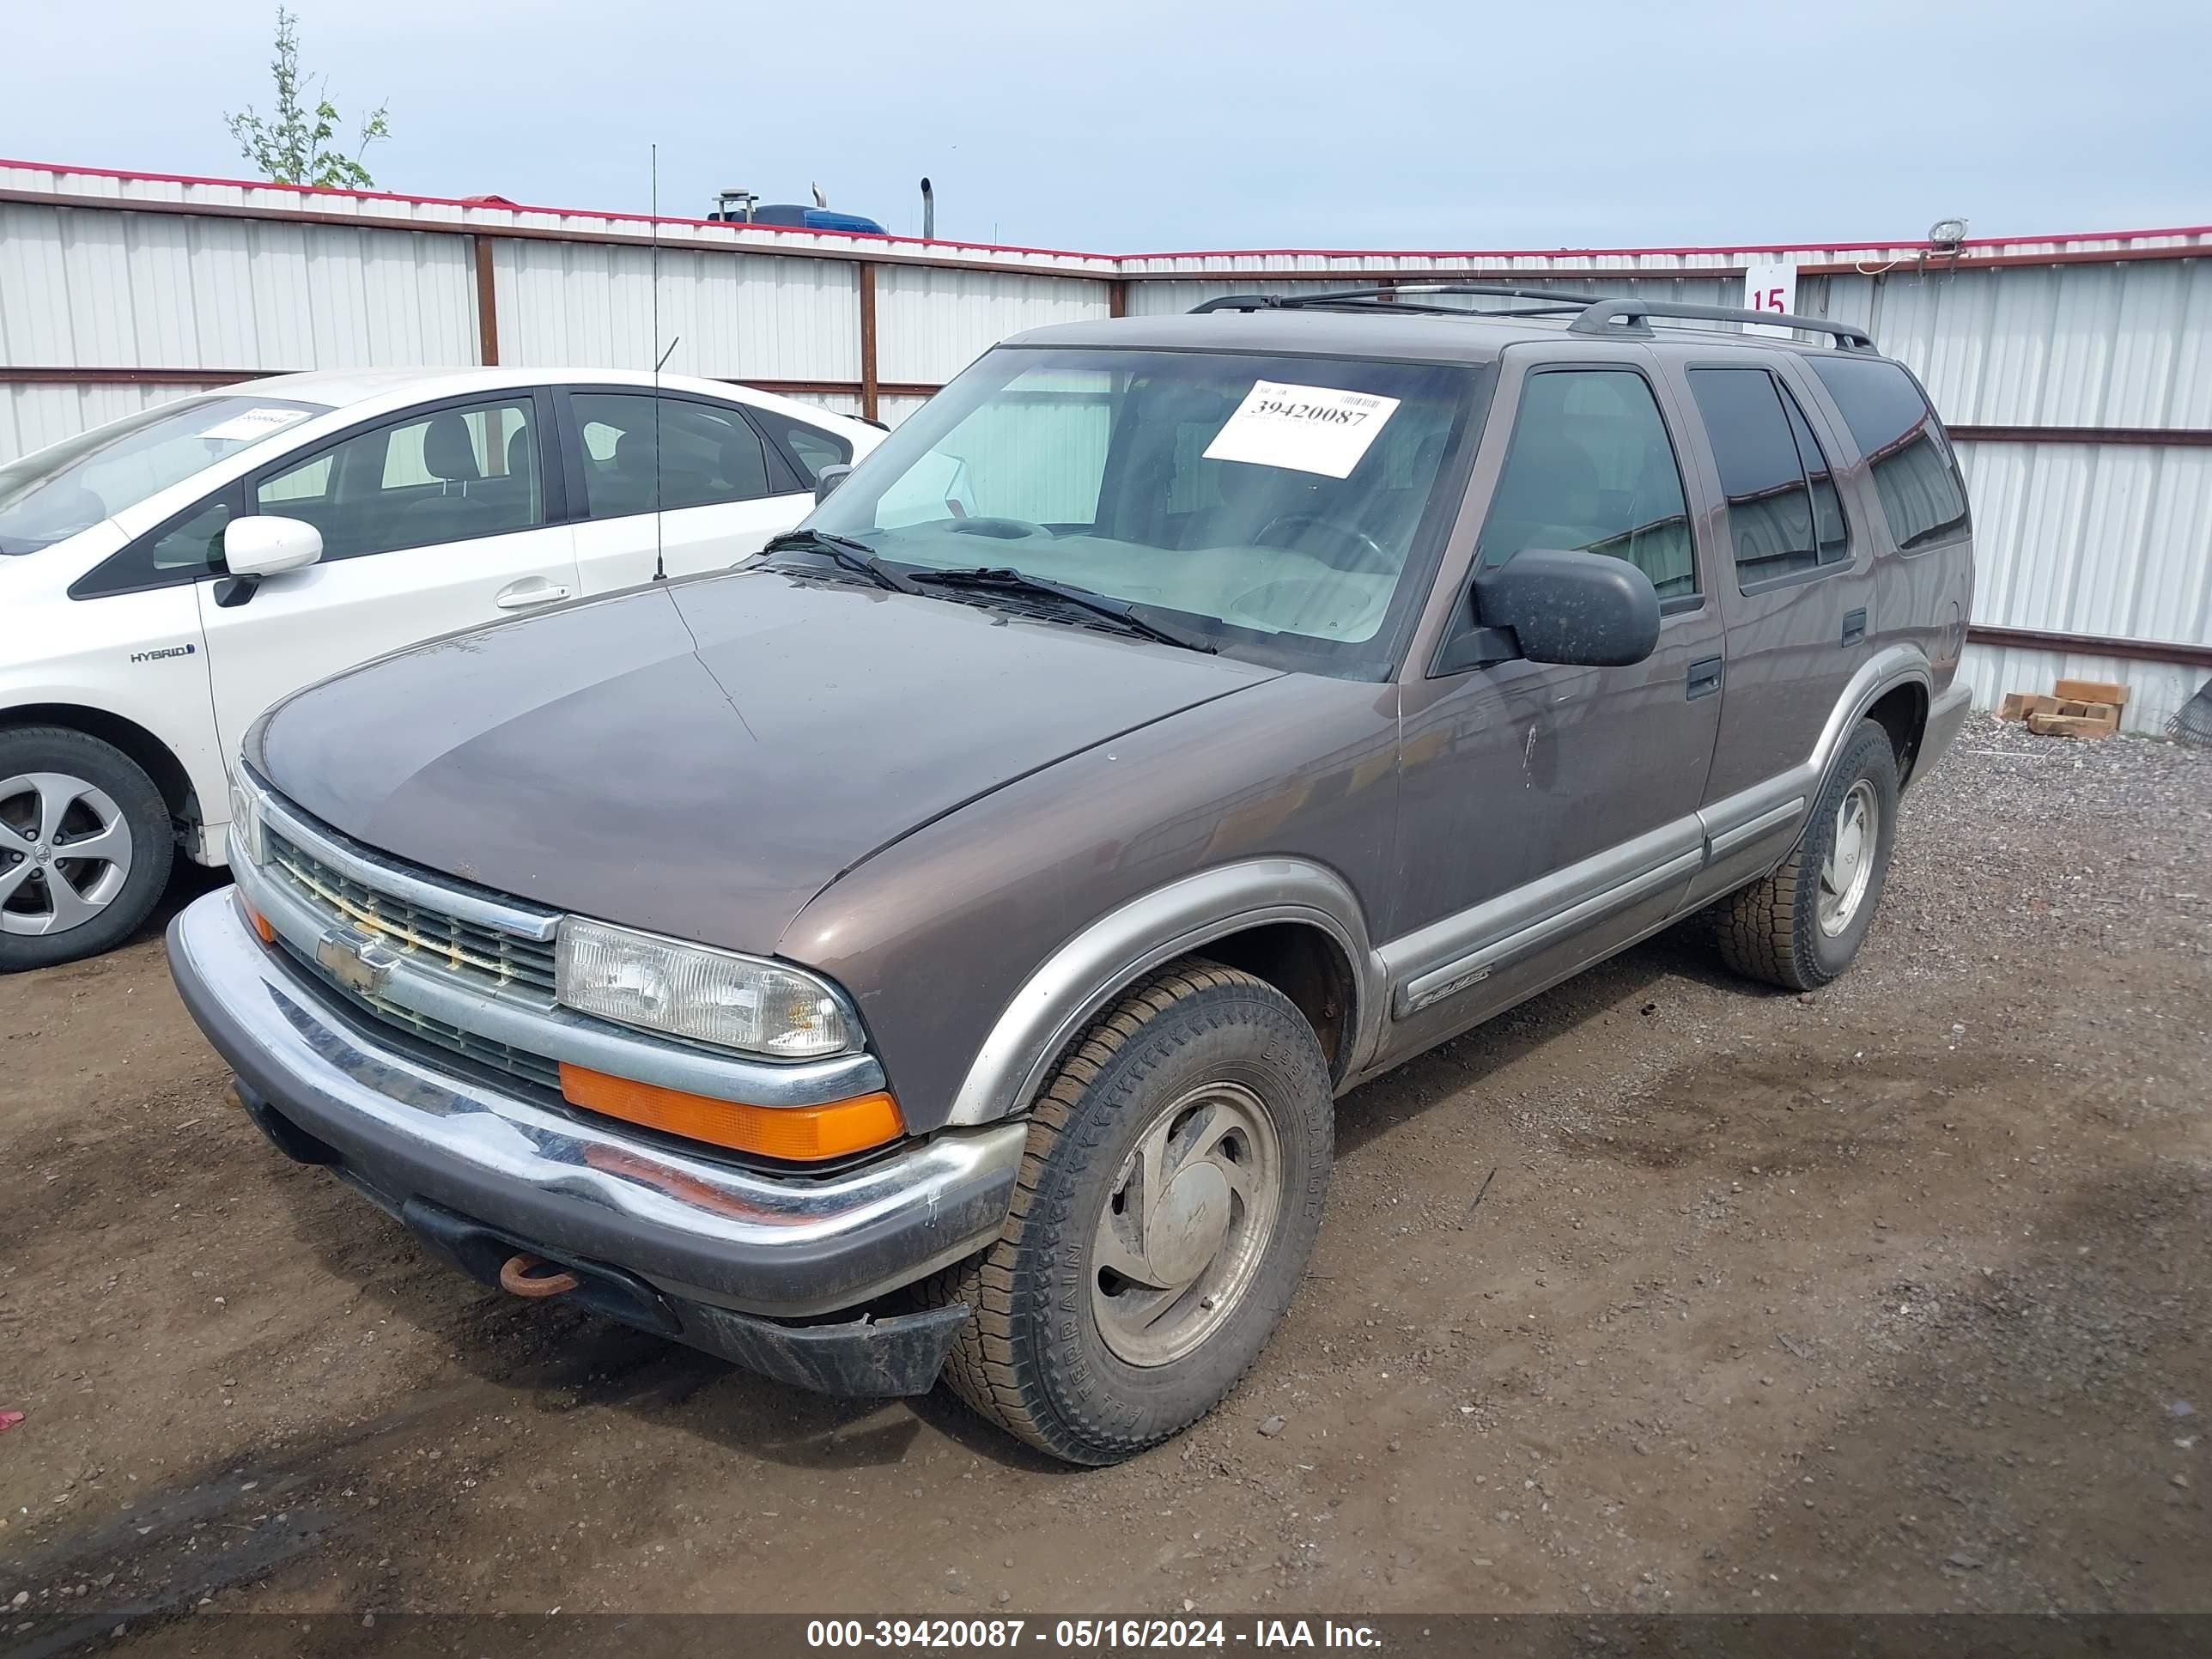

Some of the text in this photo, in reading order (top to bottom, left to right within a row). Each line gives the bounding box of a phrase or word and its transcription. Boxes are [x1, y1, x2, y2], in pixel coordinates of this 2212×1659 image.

[1754, 289, 1784, 313] 15
[1251, 400, 1369, 426] 39420087
[131, 647, 185, 663] HYBRID
[1060, 1243, 1145, 1429] ALL TERRAIN
